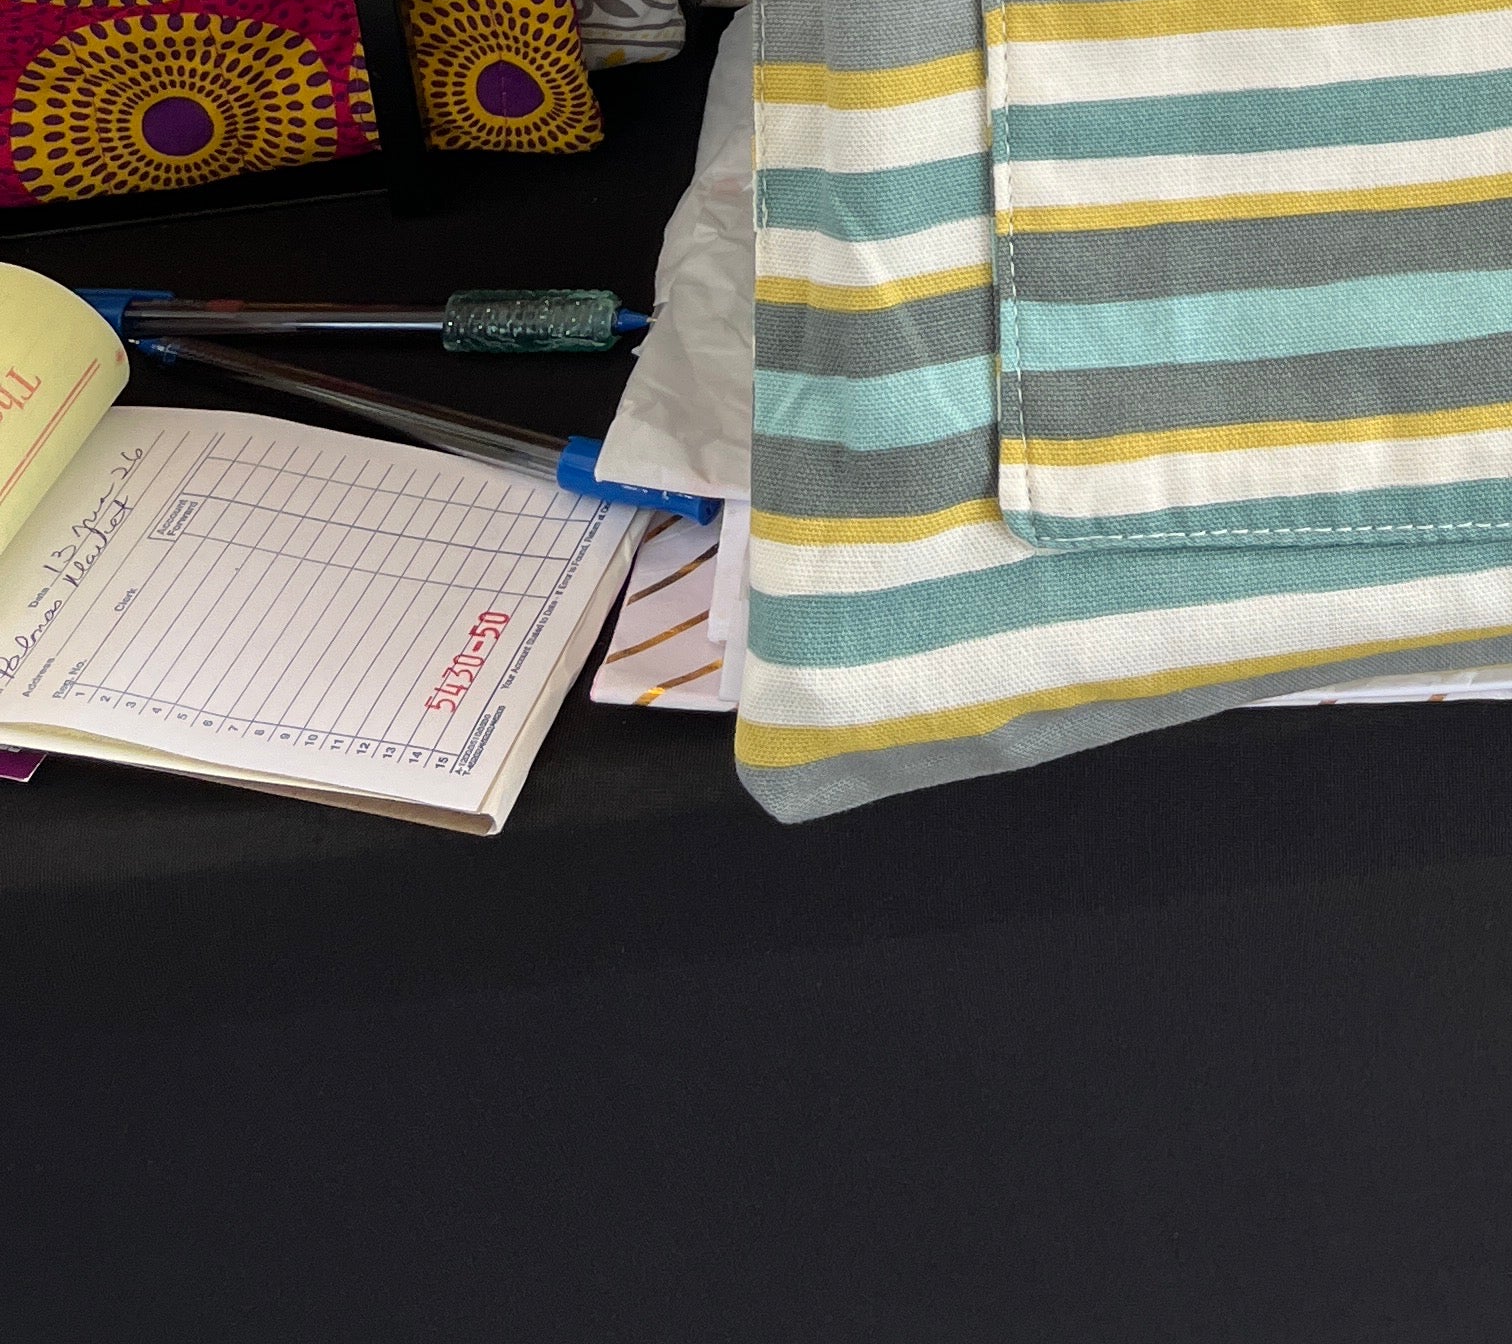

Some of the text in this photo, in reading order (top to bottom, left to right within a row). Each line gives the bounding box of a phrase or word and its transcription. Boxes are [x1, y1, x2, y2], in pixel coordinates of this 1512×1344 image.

[157, 499, 188, 535] Account
[167, 501, 198, 537] Forward
[22, 657, 55, 698] Address
[100, 695, 111, 703] 2
[126, 701, 137, 709] 3
[152, 706, 163, 714] 4
[177, 712, 188, 720] 5
[202, 719, 214, 727] 6
[228, 724, 239, 732] 7
[304, 734, 319, 747] 10
[330, 738, 345, 750] 11
[356, 742, 371, 755] 12
[382, 746, 397, 759] 13
[409, 750, 423, 764] 14
[435, 756, 449, 769] 15
